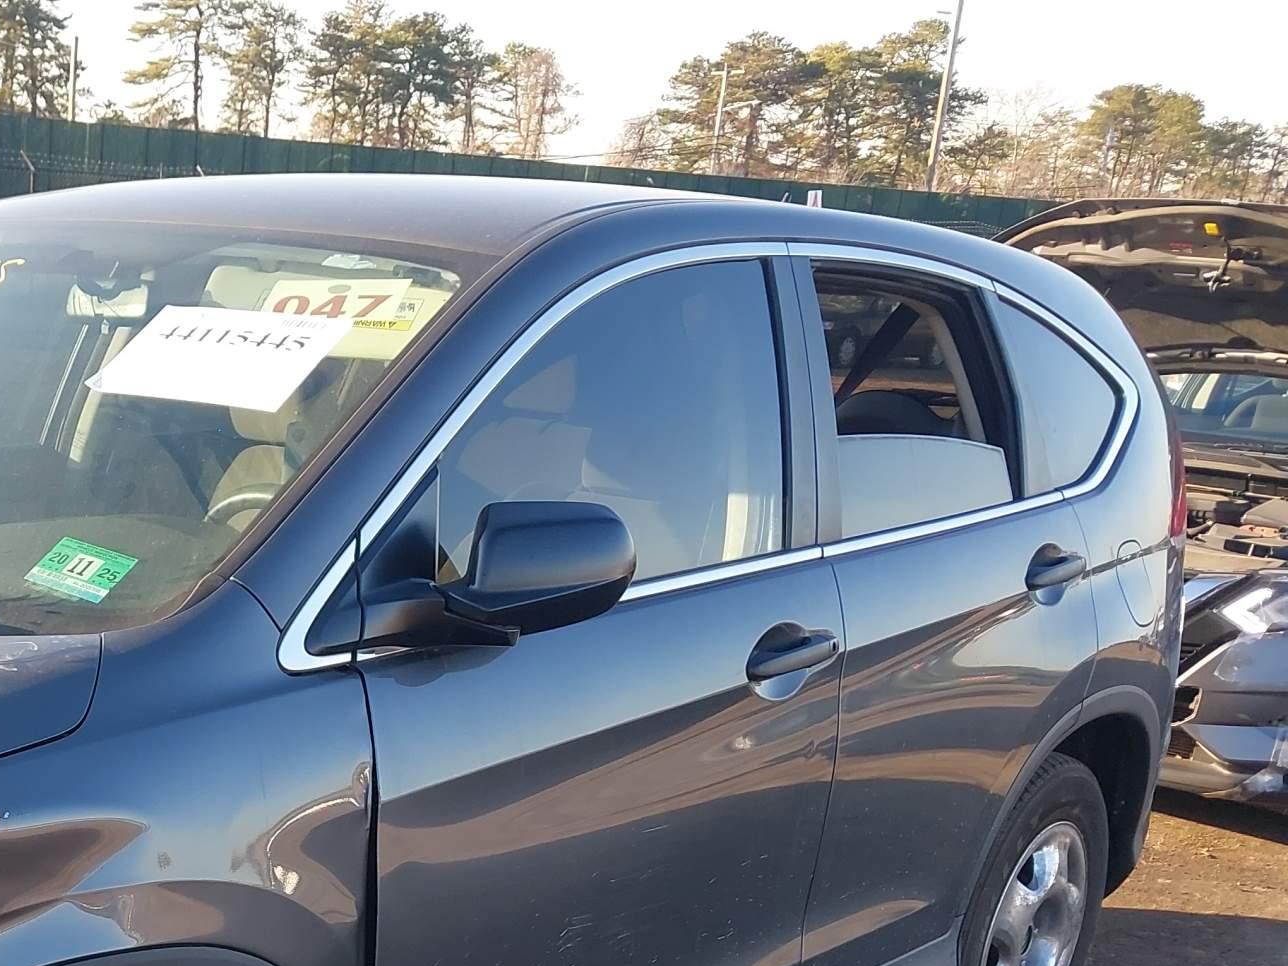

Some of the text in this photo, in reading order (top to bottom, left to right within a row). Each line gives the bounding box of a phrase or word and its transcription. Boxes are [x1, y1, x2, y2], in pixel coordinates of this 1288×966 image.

[272, 294, 393, 319] 047
[159, 325, 311, 352] 44115445
[48, 551, 121, 582] 20 11 25
